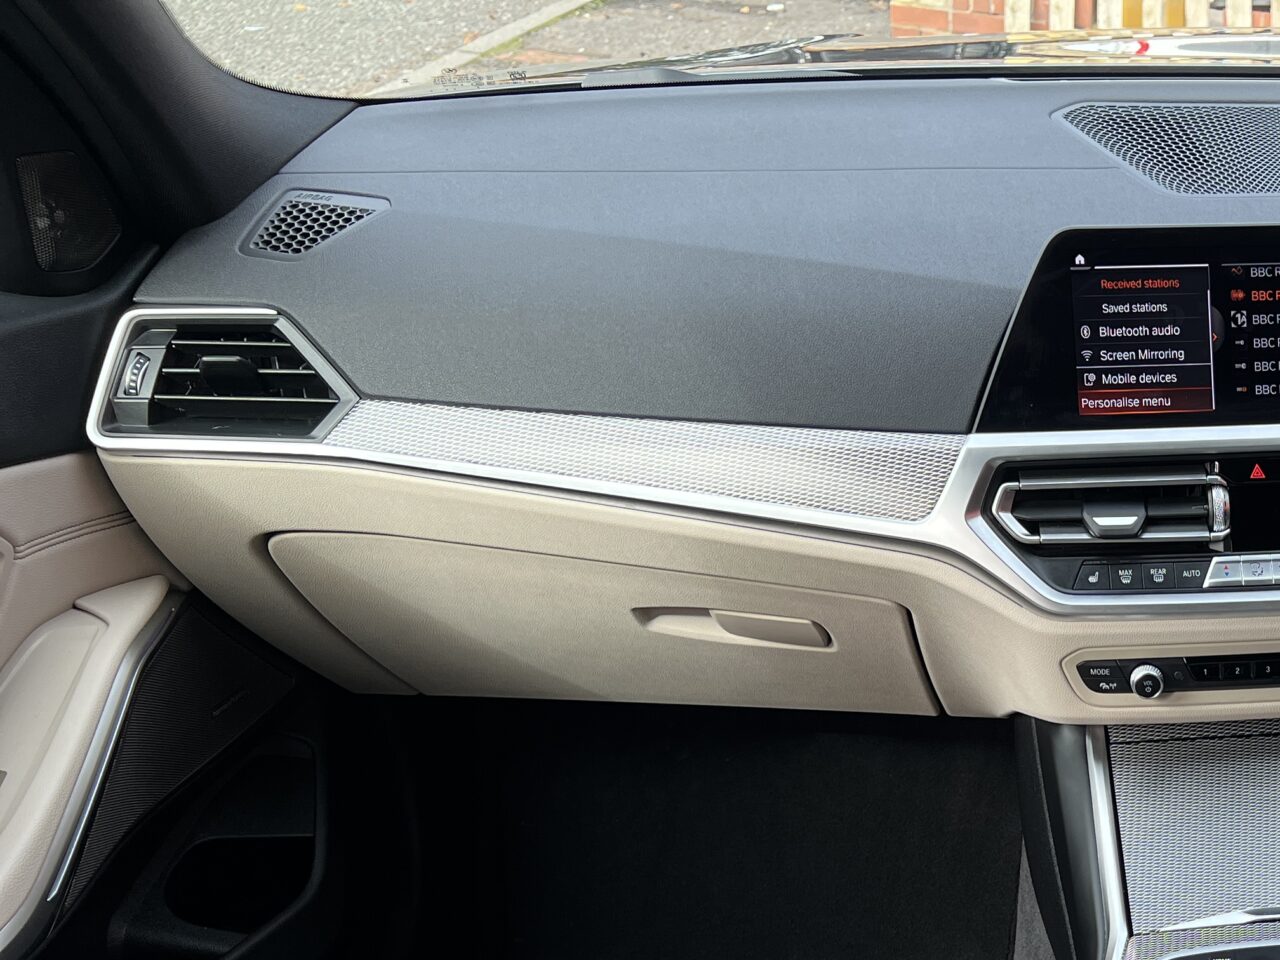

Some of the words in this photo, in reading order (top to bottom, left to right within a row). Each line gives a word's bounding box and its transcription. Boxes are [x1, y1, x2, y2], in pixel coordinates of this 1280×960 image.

[1250, 266, 1273, 277] BBC
[1101, 279, 1142, 290] Received
[1144, 278, 1180, 289] stations
[1251, 290, 1274, 301] BBC
[1102, 303, 1131, 314] Saved
[1131, 303, 1168, 313] stations
[1252, 314, 1275, 325] BBC
[1099, 325, 1150, 337] Bluetooth
[1152, 325, 1181, 336] audio
[1253, 337, 1276, 349] BBC
[1100, 350, 1137, 361] Screen
[1138, 349, 1185, 361] Mirroring
[1254, 361, 1277, 372] BBC
[1101, 373, 1137, 385] Mobile
[1139, 372, 1178, 384] devices
[1255, 384, 1277, 395] BBC
[1081, 397, 1140, 409] Personalise
[1142, 396, 1171, 407] menu
[1150, 568, 1167, 576] REAR
[1182, 570, 1201, 578] AUTO
[1090, 668, 1111, 676] MODE
